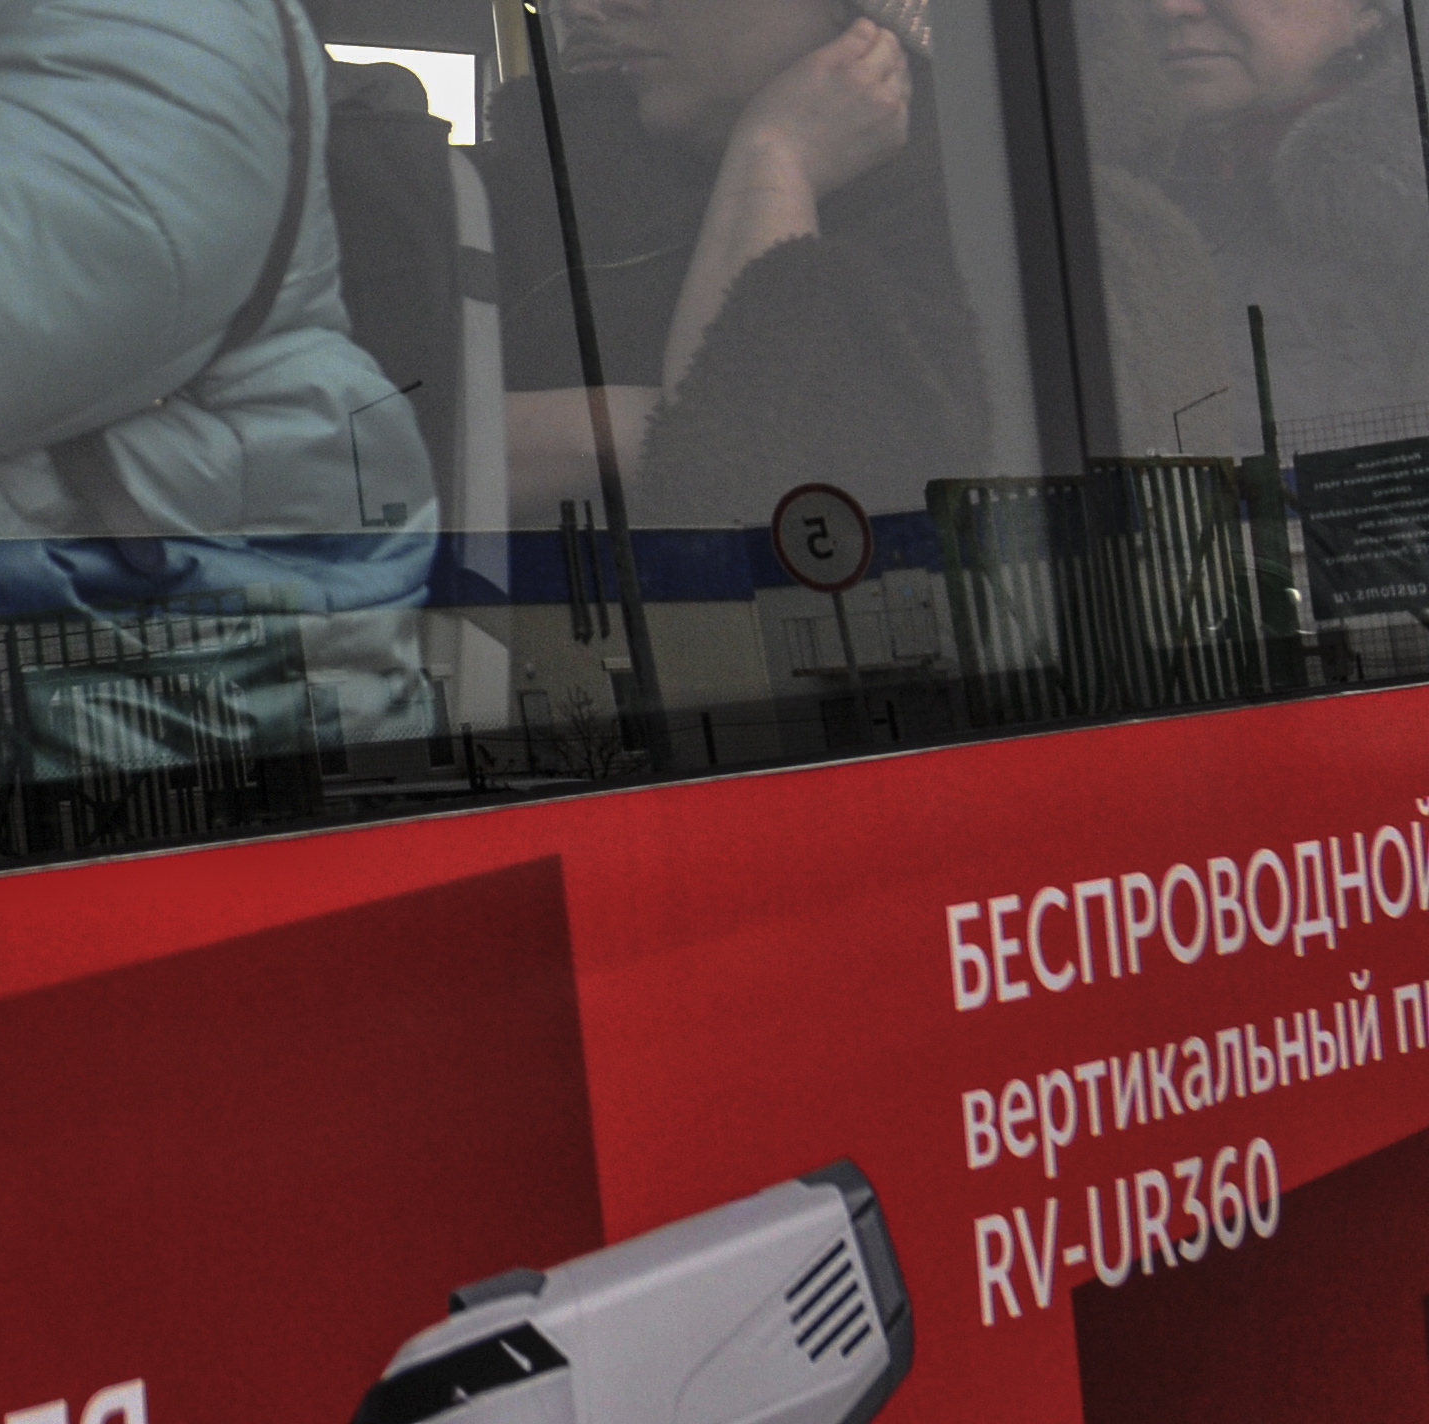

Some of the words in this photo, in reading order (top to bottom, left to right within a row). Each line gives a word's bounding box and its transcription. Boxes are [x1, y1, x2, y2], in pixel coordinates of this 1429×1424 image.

[960, 968, 1383, 1179] вертикальный
[1392, 979, 1429, 1055] п
[973, 1137, 1281, 1327] RV-UR360
